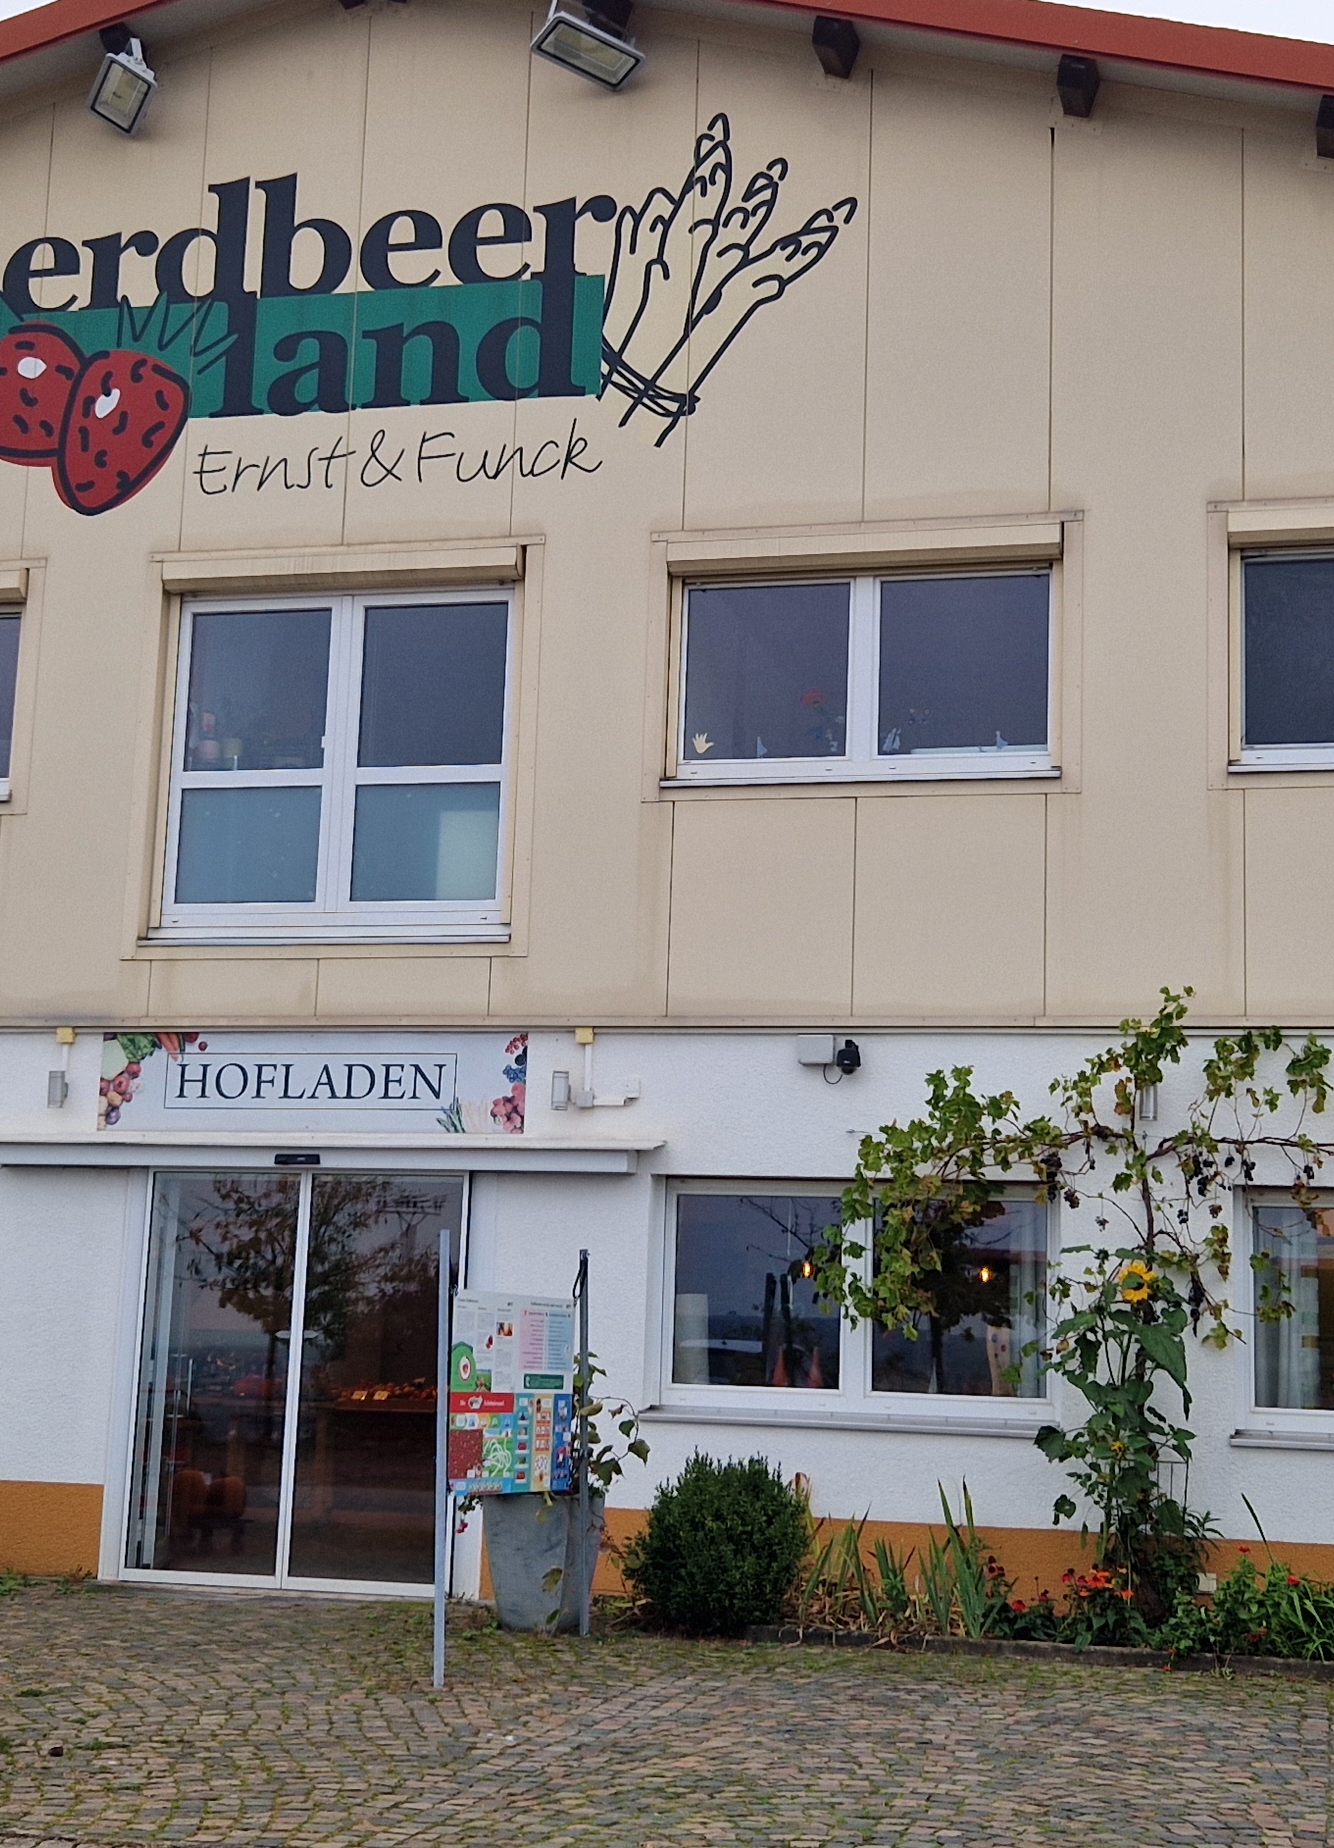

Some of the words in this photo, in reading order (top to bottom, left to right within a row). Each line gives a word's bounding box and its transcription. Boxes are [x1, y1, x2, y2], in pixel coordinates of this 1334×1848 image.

[2, 173, 617, 314] erdbeer
[209, 280, 591, 418] land
[193, 435, 355, 496] Ernst
[359, 429, 406, 488] &
[414, 418, 602, 484] Funck
[176, 1062, 446, 1099] HOFLADEN
